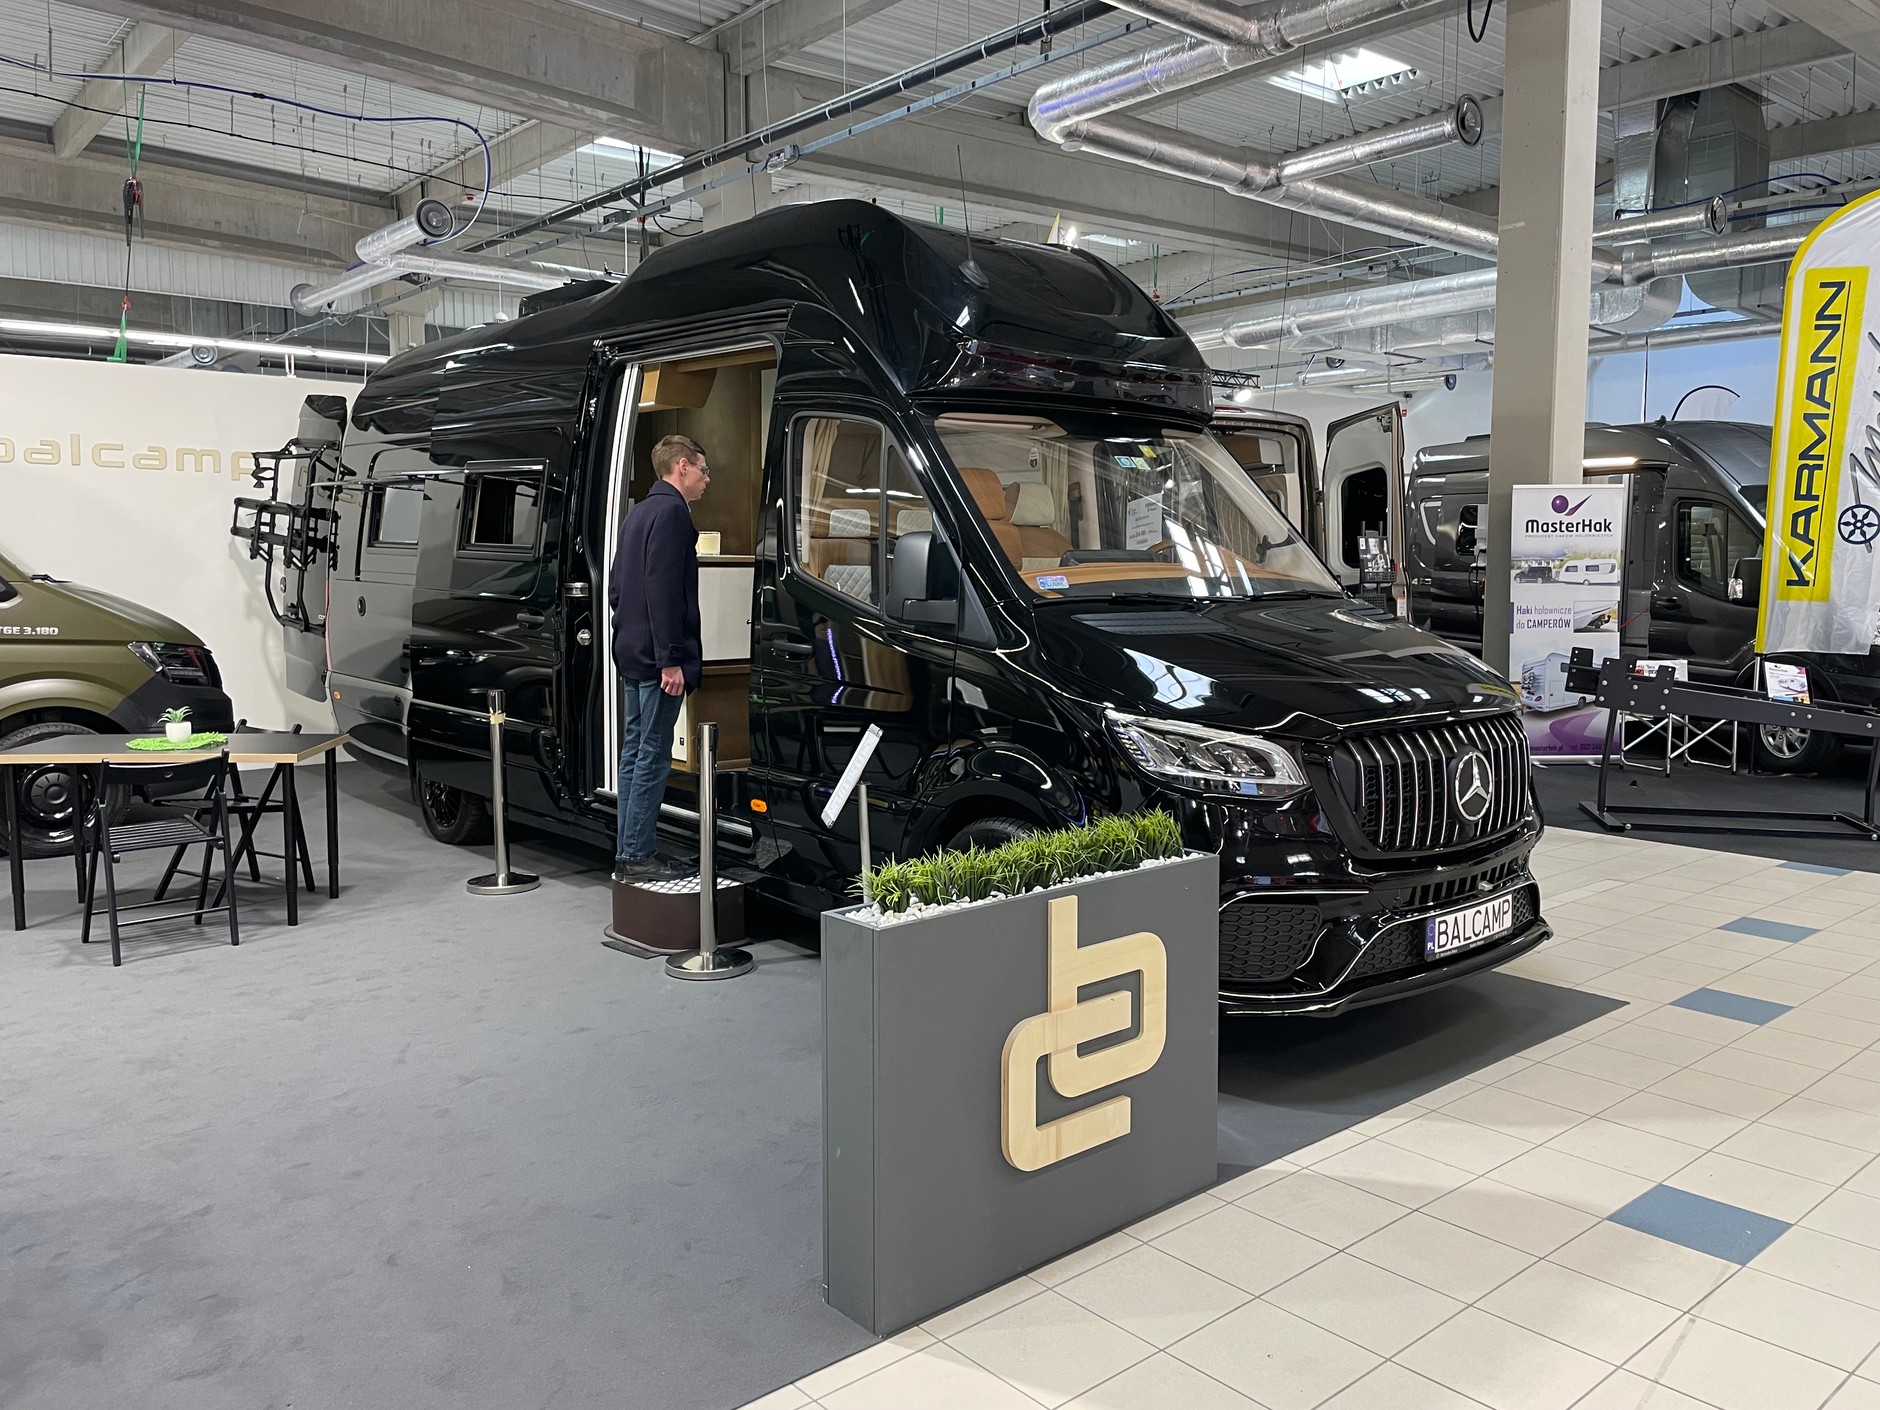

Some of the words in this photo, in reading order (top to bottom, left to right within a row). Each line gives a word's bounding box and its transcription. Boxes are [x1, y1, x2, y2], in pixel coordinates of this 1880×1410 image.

[1786, 280, 1847, 587] KARMANN
[1525, 518, 1612, 533] MasterHak
[1516, 605, 1533, 615] Haki
[1534, 605, 1572, 615] holownicze
[1516, 621, 1525, 629] do
[1526, 617, 1571, 629] CAMPERÓW
[23, 626, 59, 635] 3.180
[1437, 898, 1511, 950] BALCAMP
[1427, 942, 1435, 951] PL
